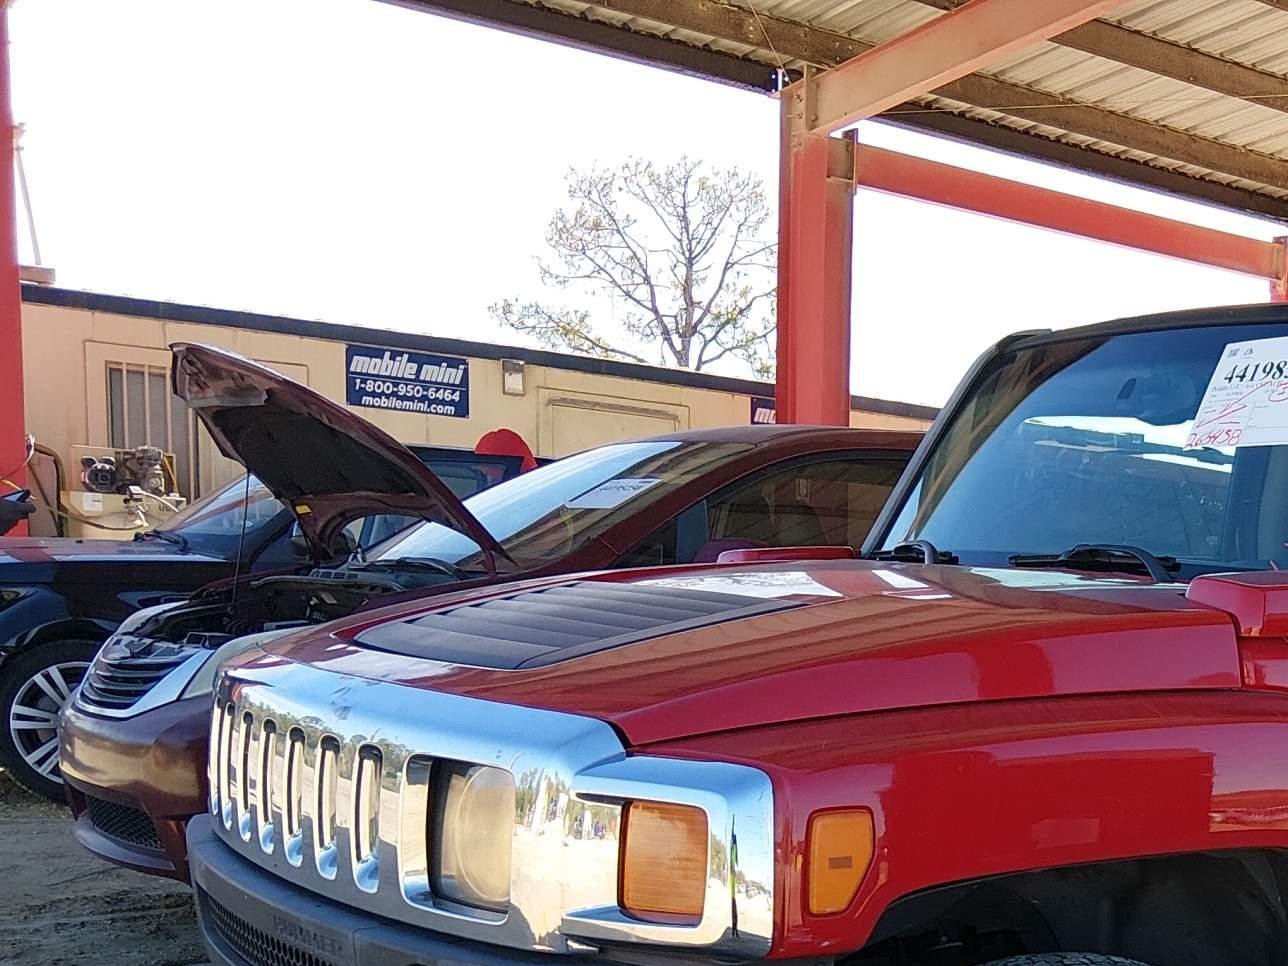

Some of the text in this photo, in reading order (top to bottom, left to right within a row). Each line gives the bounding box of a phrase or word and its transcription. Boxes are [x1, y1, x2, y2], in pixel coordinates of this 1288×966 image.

[350, 351, 465, 384] mobile mini
[355, 379, 460, 402] 1-800-950-6464
[361, 396, 455, 415] mobilemini.com
